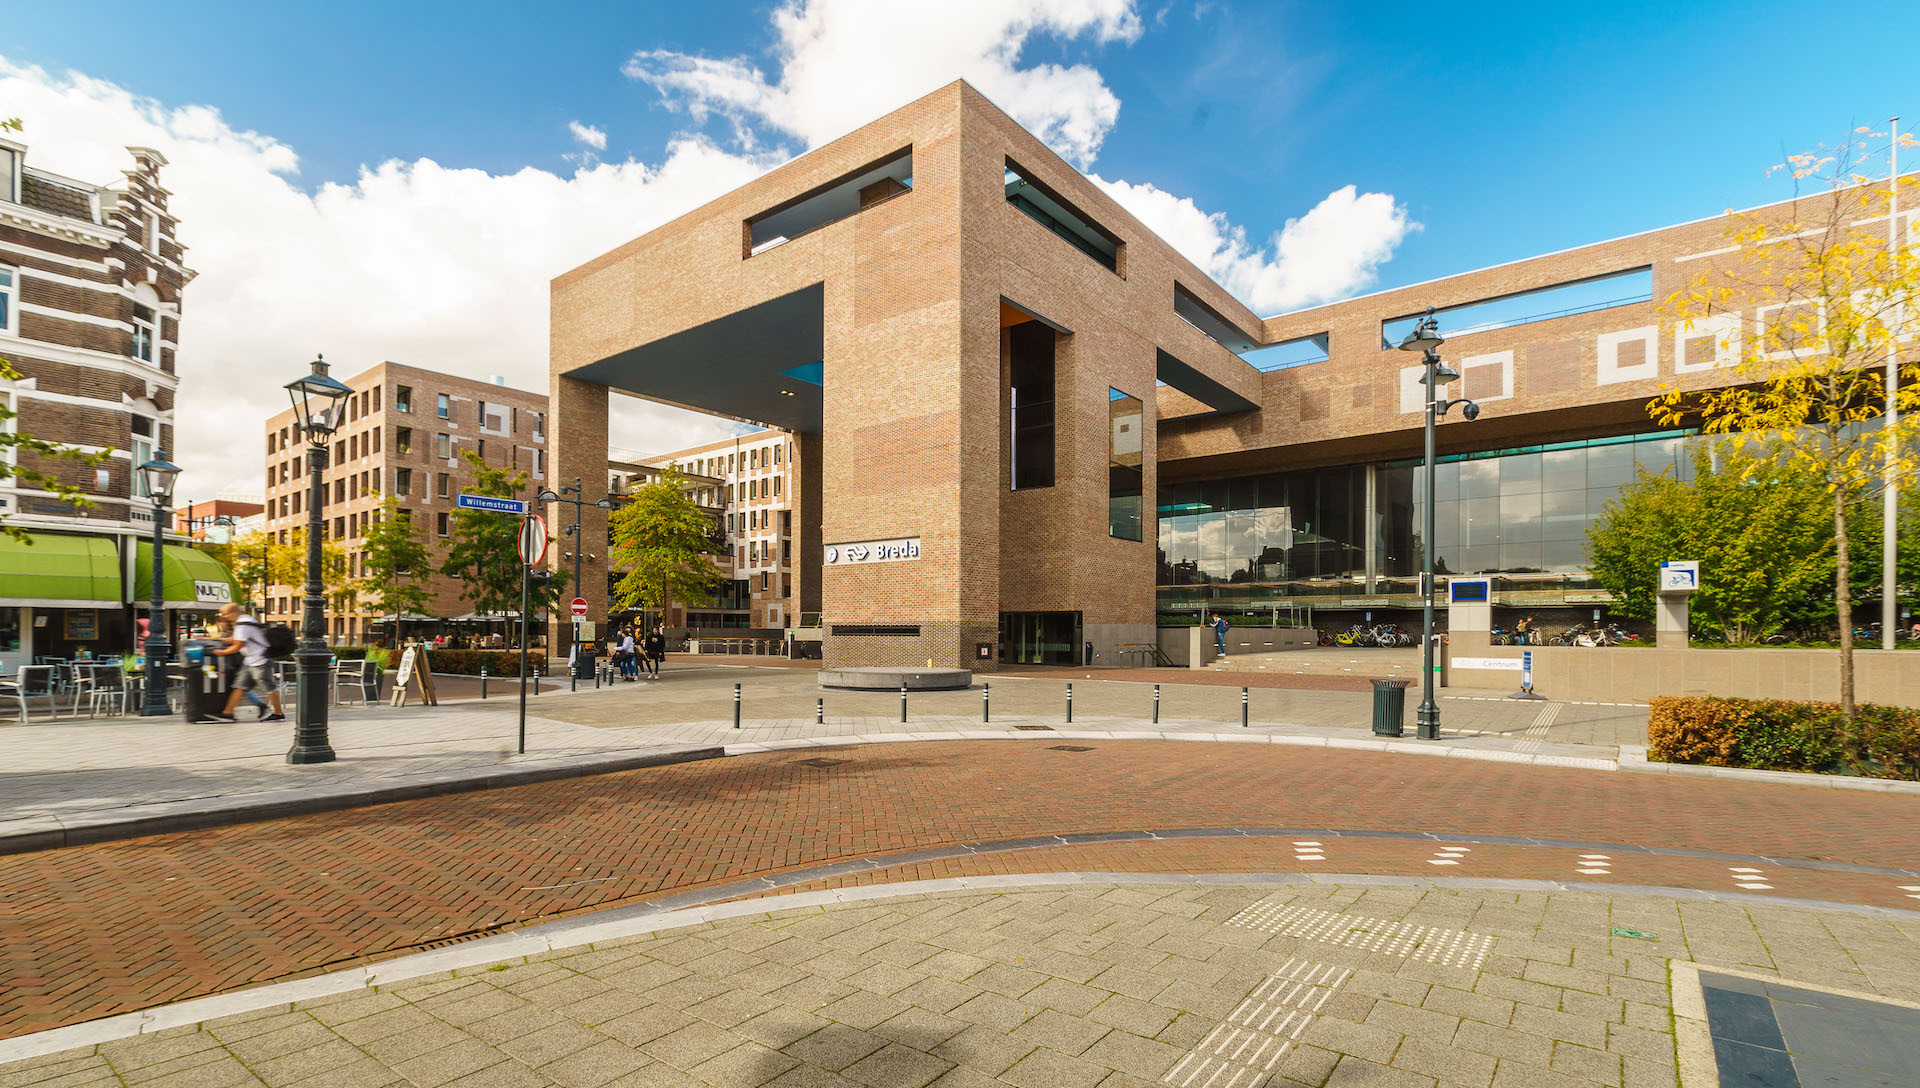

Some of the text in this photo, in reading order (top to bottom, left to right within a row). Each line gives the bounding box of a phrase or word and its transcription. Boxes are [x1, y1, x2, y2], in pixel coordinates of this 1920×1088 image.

[466, 498, 517, 510] Willemstraat
[876, 541, 919, 560] Breda
[195, 584, 230, 601] NUL76
[1482, 660, 1518, 668] Centrum
